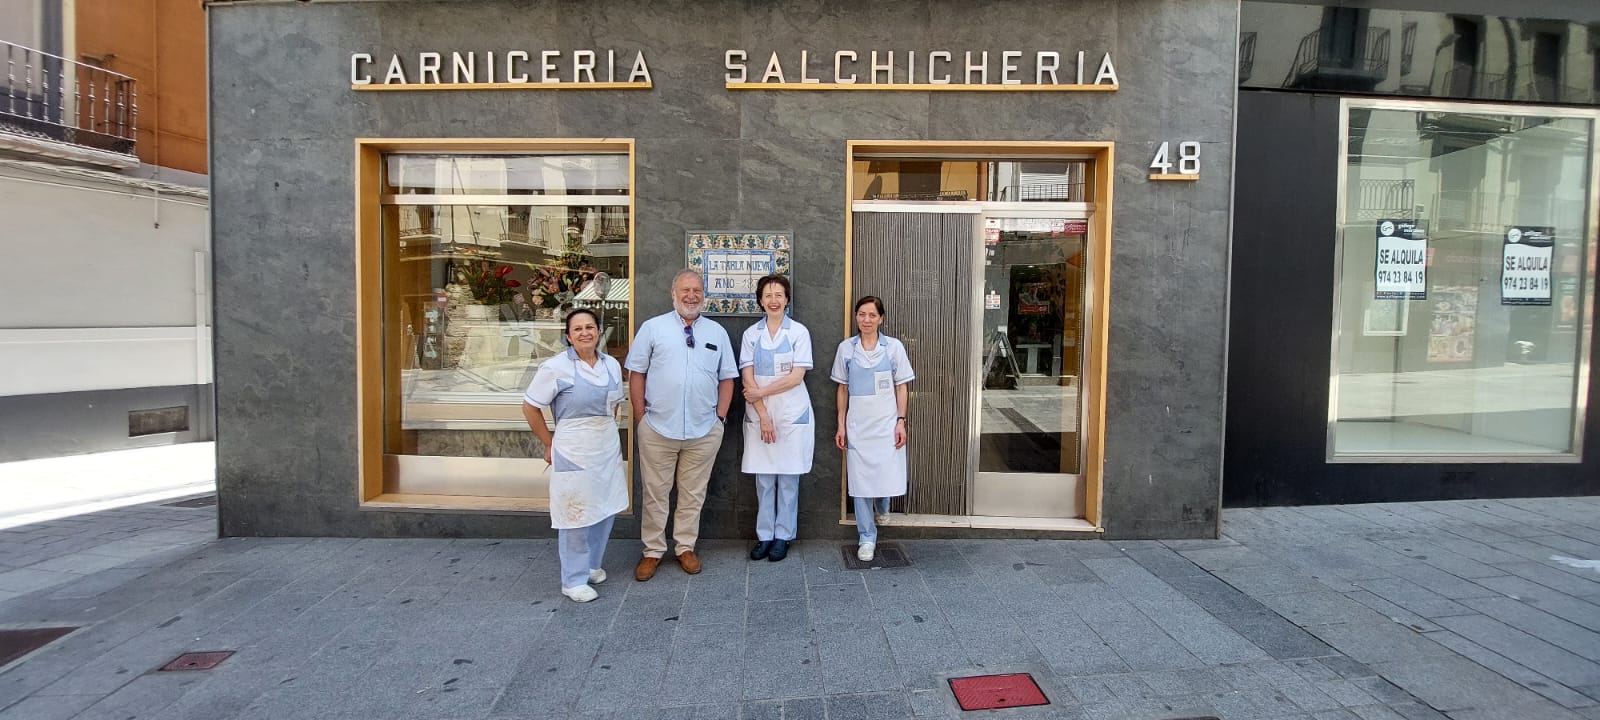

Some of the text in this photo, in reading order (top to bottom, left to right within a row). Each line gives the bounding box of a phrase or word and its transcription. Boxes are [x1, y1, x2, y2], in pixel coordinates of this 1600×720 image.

[351, 49, 651, 85] CARNICERIA
[725, 49, 1119, 85] SALCHICHERIA
[1149, 141, 1201, 175] 48
[1379, 249, 1424, 265] SE ALQUILA
[1505, 255, 1516, 271] SE
[1517, 256, 1548, 271] ALQUILA
[709, 260, 719, 271] LA
[746, 260, 770, 271] NUEVA
[1378, 270, 1424, 284] 974 23 84 19
[1504, 277, 1549, 291] 974 23 84 19
